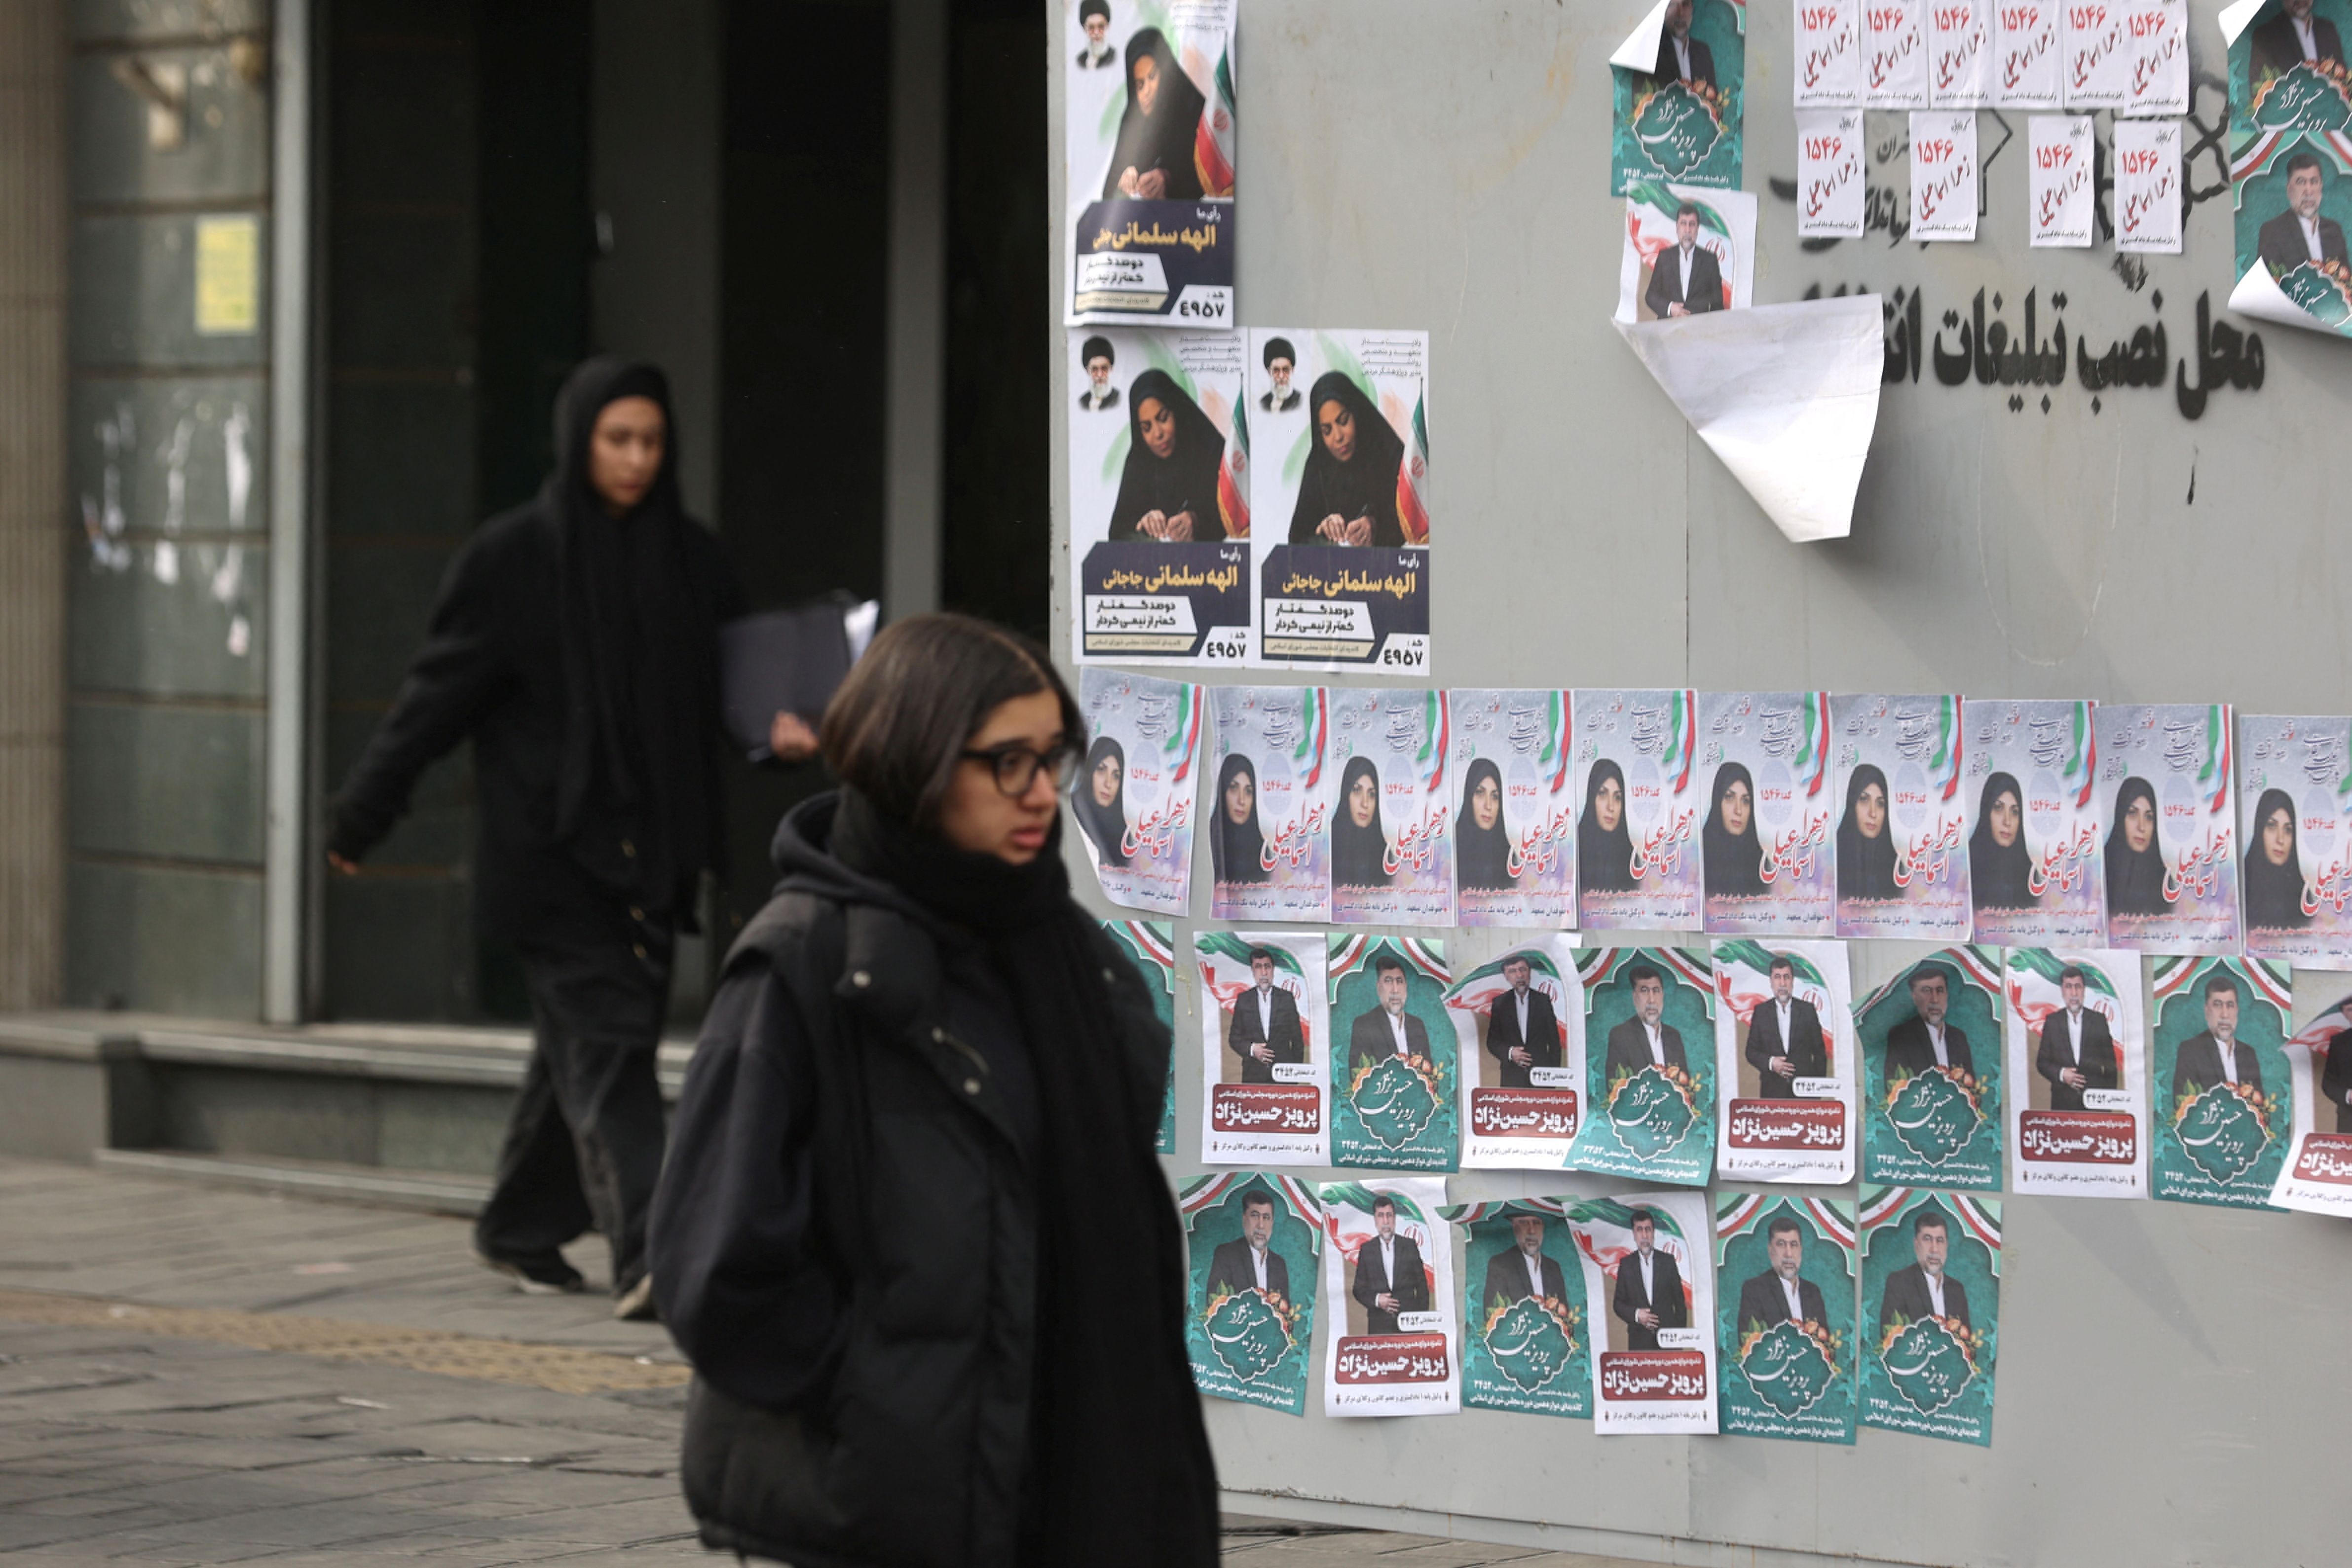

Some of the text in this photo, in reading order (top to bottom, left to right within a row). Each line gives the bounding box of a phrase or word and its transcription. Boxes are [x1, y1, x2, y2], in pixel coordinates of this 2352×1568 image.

[1801, 6, 1837, 31] ۱۵۴۶
[1867, 7, 1904, 32] ۱۵۴۶
[1935, 6, 1970, 31] ۱۵۴۶
[2002, 6, 2038, 32] ۱۵۴۶
[2069, 5, 2106, 31] ۱۵۴۶
[2128, 11, 2165, 37] ۱۵۴۶
[1806, 136, 1841, 160] ۱۵۴۶
[1918, 138, 1954, 163] ۱۵۴۶
[2037, 143, 2072, 169] ۱۵۴۶
[2122, 149, 2159, 174] ۱۵۴۶
[1112, 222, 1178, 250] سلمانی
[1180, 224, 1216, 253] الهه
[1933, 285, 2067, 414] تبلیغات
[2077, 288, 2168, 415] نصب
[2177, 288, 2265, 420] محل
[1145, 564, 1204, 593] سلمانی
[1206, 565, 1238, 593] الهه
[1324, 569, 1382, 597] سلمانی
[1384, 571, 1416, 599] الهه
[1120, 791, 1191, 859] زهرا اسماعیلی
[1260, 798, 1325, 872] زهرا اسماعیلی
[1383, 801, 1448, 876] زهرا اسماعیلی
[1507, 803, 1570, 878] زهرا اسماعیلی
[1630, 804, 1695, 881] زهرا اسماعیلی
[1759, 807, 1829, 885] زهرا اسماعیلی
[1893, 811, 1963, 889] زهرا اسماعیلی
[2028, 819, 2097, 897] زهرا اسماعیلی
[2162, 824, 2231, 903] زهرا اسماعیلی
[1281, 1106, 1318, 1128] پرویز
[1389, 1101, 1415, 1131] پرویز
[1538, 1111, 1574, 1133] پرویز
[1646, 1113, 1672, 1144] پرویز
[1802, 1122, 1842, 1145] پرویز
[1928, 1116, 1956, 1147] پرویز
[2093, 1135, 2133, 1158] پرویز
[2216, 1133, 2244, 1165] پرویز
[1242, 1334, 1267, 1366] پرویز
[1524, 1344, 1550, 1375] پرویز
[1409, 1356, 1446, 1377] پرویز
[1922, 1365, 1949, 1397] پرویز
[1668, 1373, 1705, 1395] پرویز
[1782, 1368, 1810, 1400] پرویز
